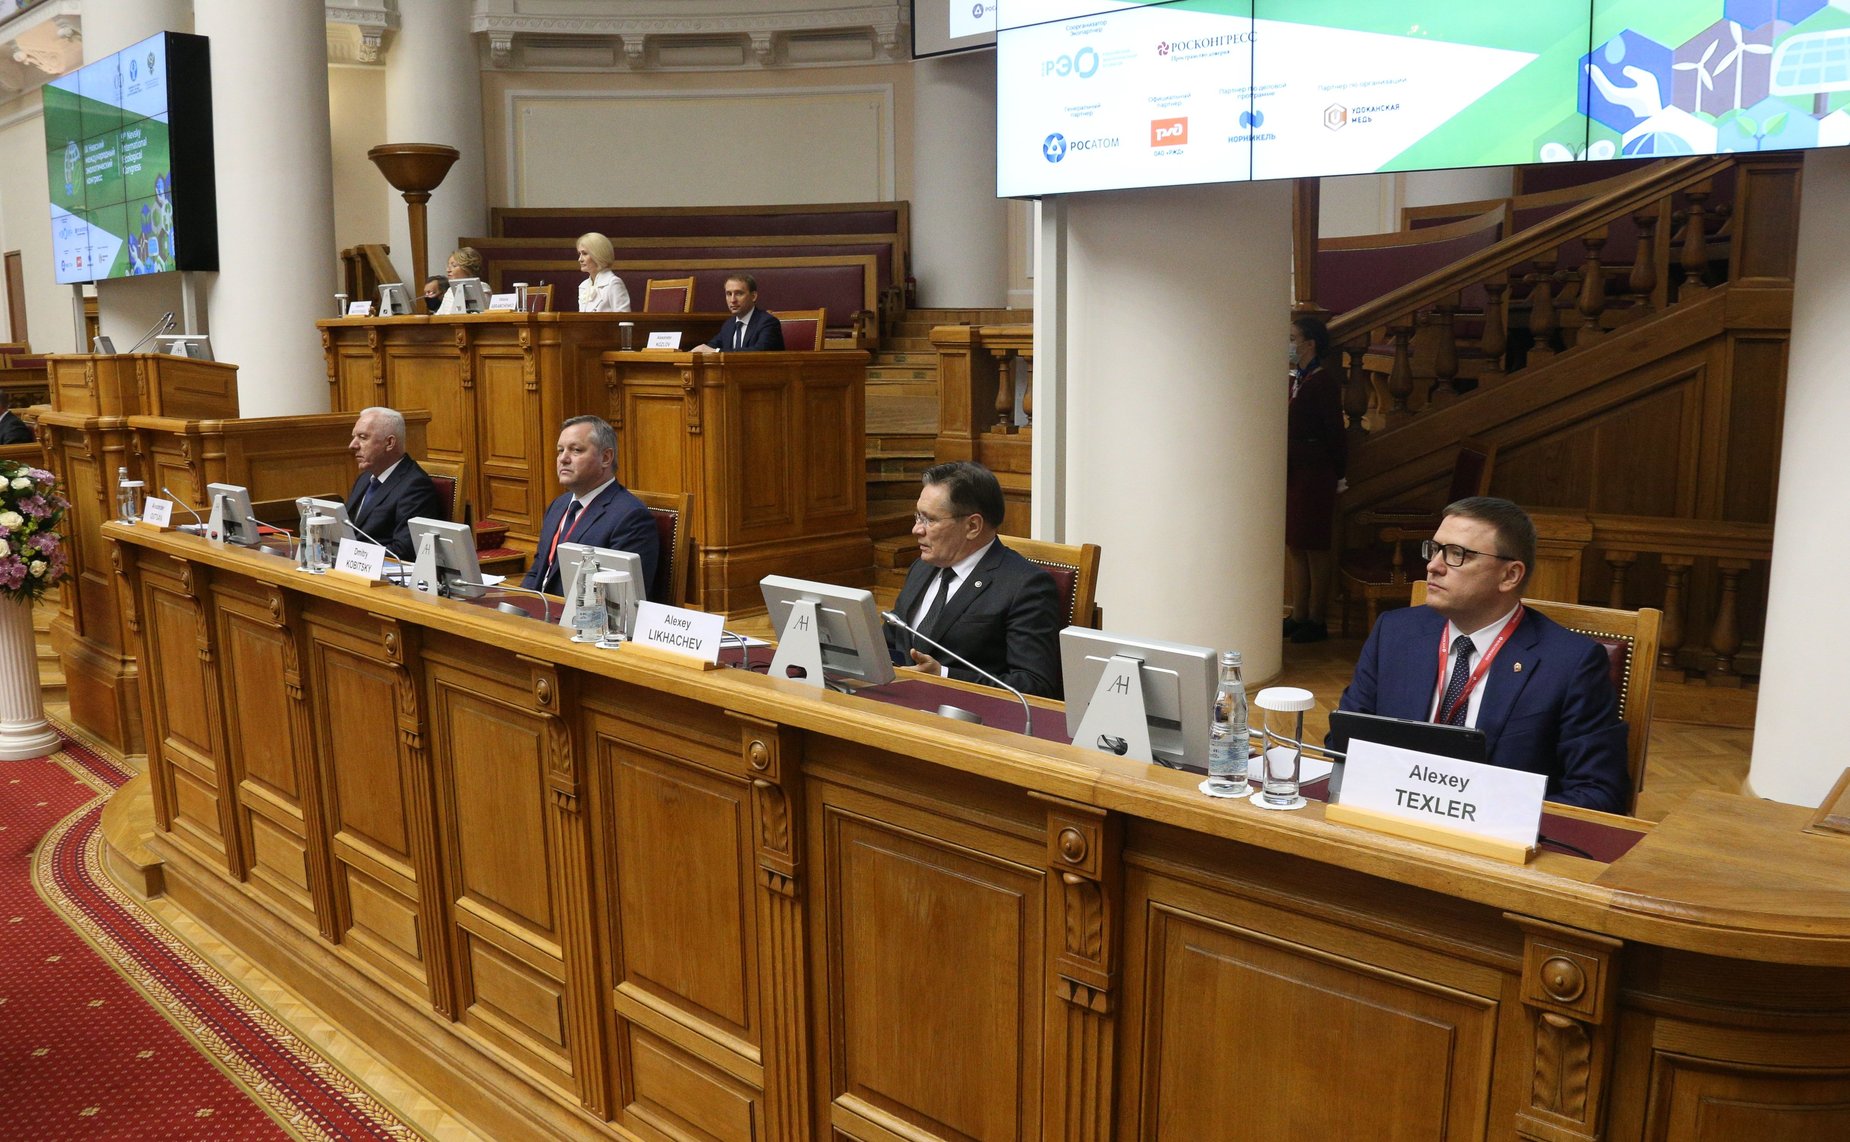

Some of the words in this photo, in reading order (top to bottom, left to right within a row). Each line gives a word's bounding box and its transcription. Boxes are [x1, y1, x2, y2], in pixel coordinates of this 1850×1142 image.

[1171, 31, 1258, 52] РОСКОНГРЕСС
[1352, 103, 1400, 114] УДОКАНСКАЯ
[1070, 137, 1120, 151] РОСАТОМ
[1228, 133, 1276, 143] НОРНИКЕЛЬ
[353, 547, 368, 559] Dmitry
[664, 614, 692, 631] Alexey
[648, 628, 703, 651] LIKHACHEV
[1408, 764, 1470, 793] Alexey
[1395, 788, 1477, 823] TEXLER
